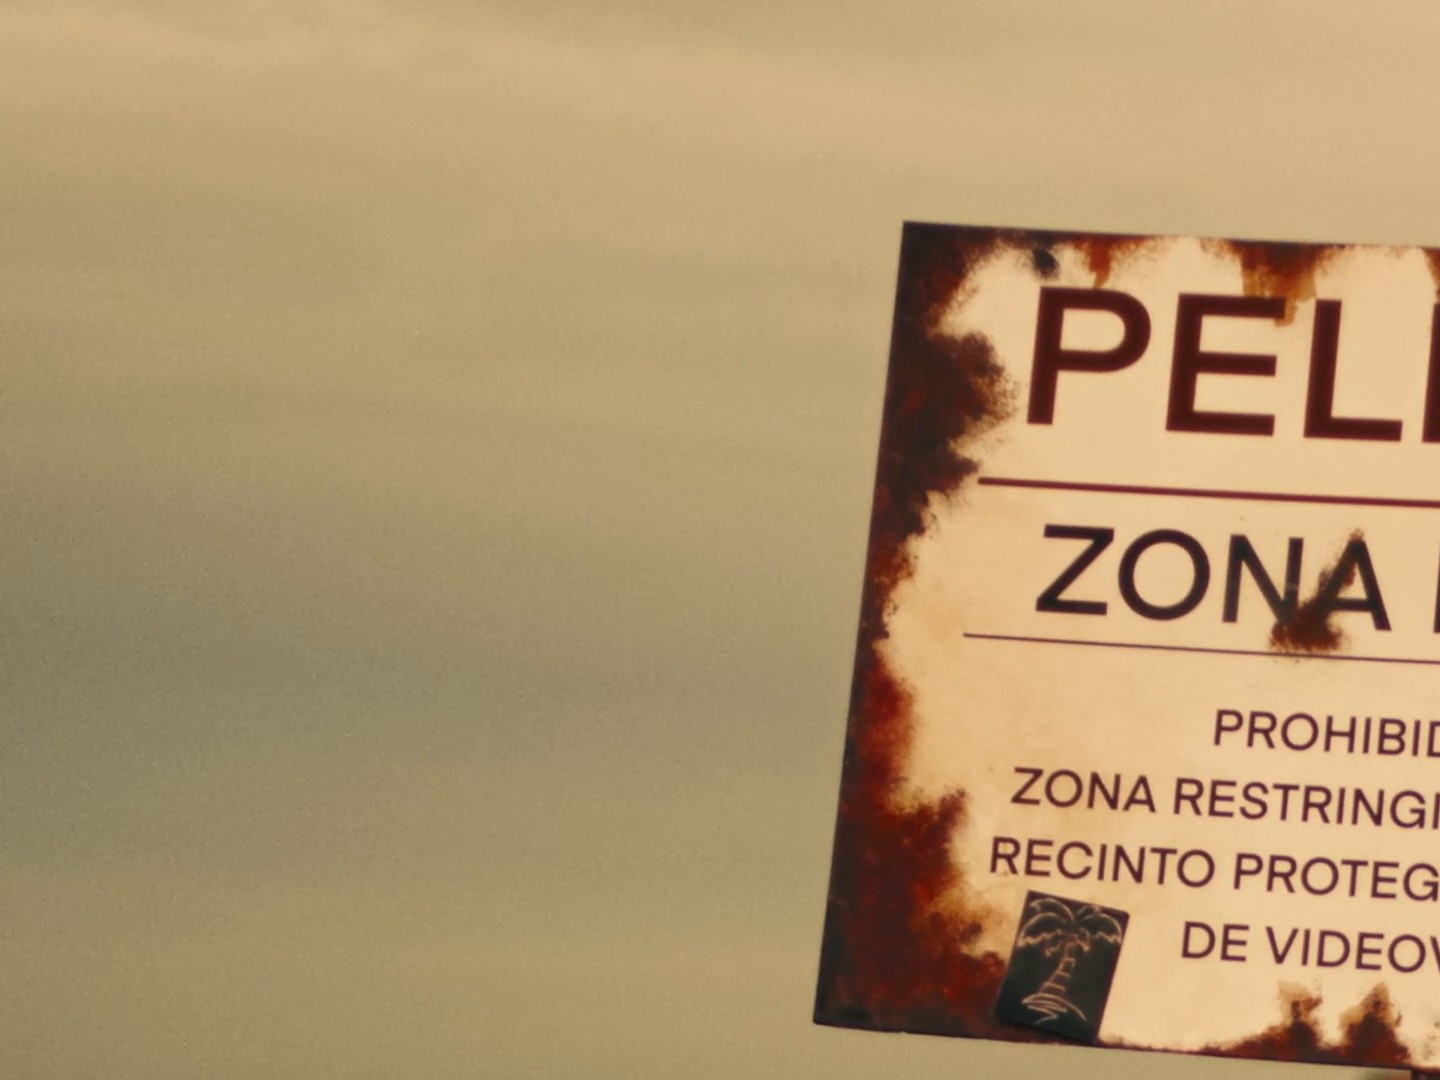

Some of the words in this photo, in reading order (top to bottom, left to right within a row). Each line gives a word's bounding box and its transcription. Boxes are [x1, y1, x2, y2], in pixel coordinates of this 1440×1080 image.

[1034, 523, 1393, 632] ZONA
[1010, 766, 1156, 814] ZONA
[989, 835, 1216, 889] RECINTO
[1180, 921, 1250, 963] DE
